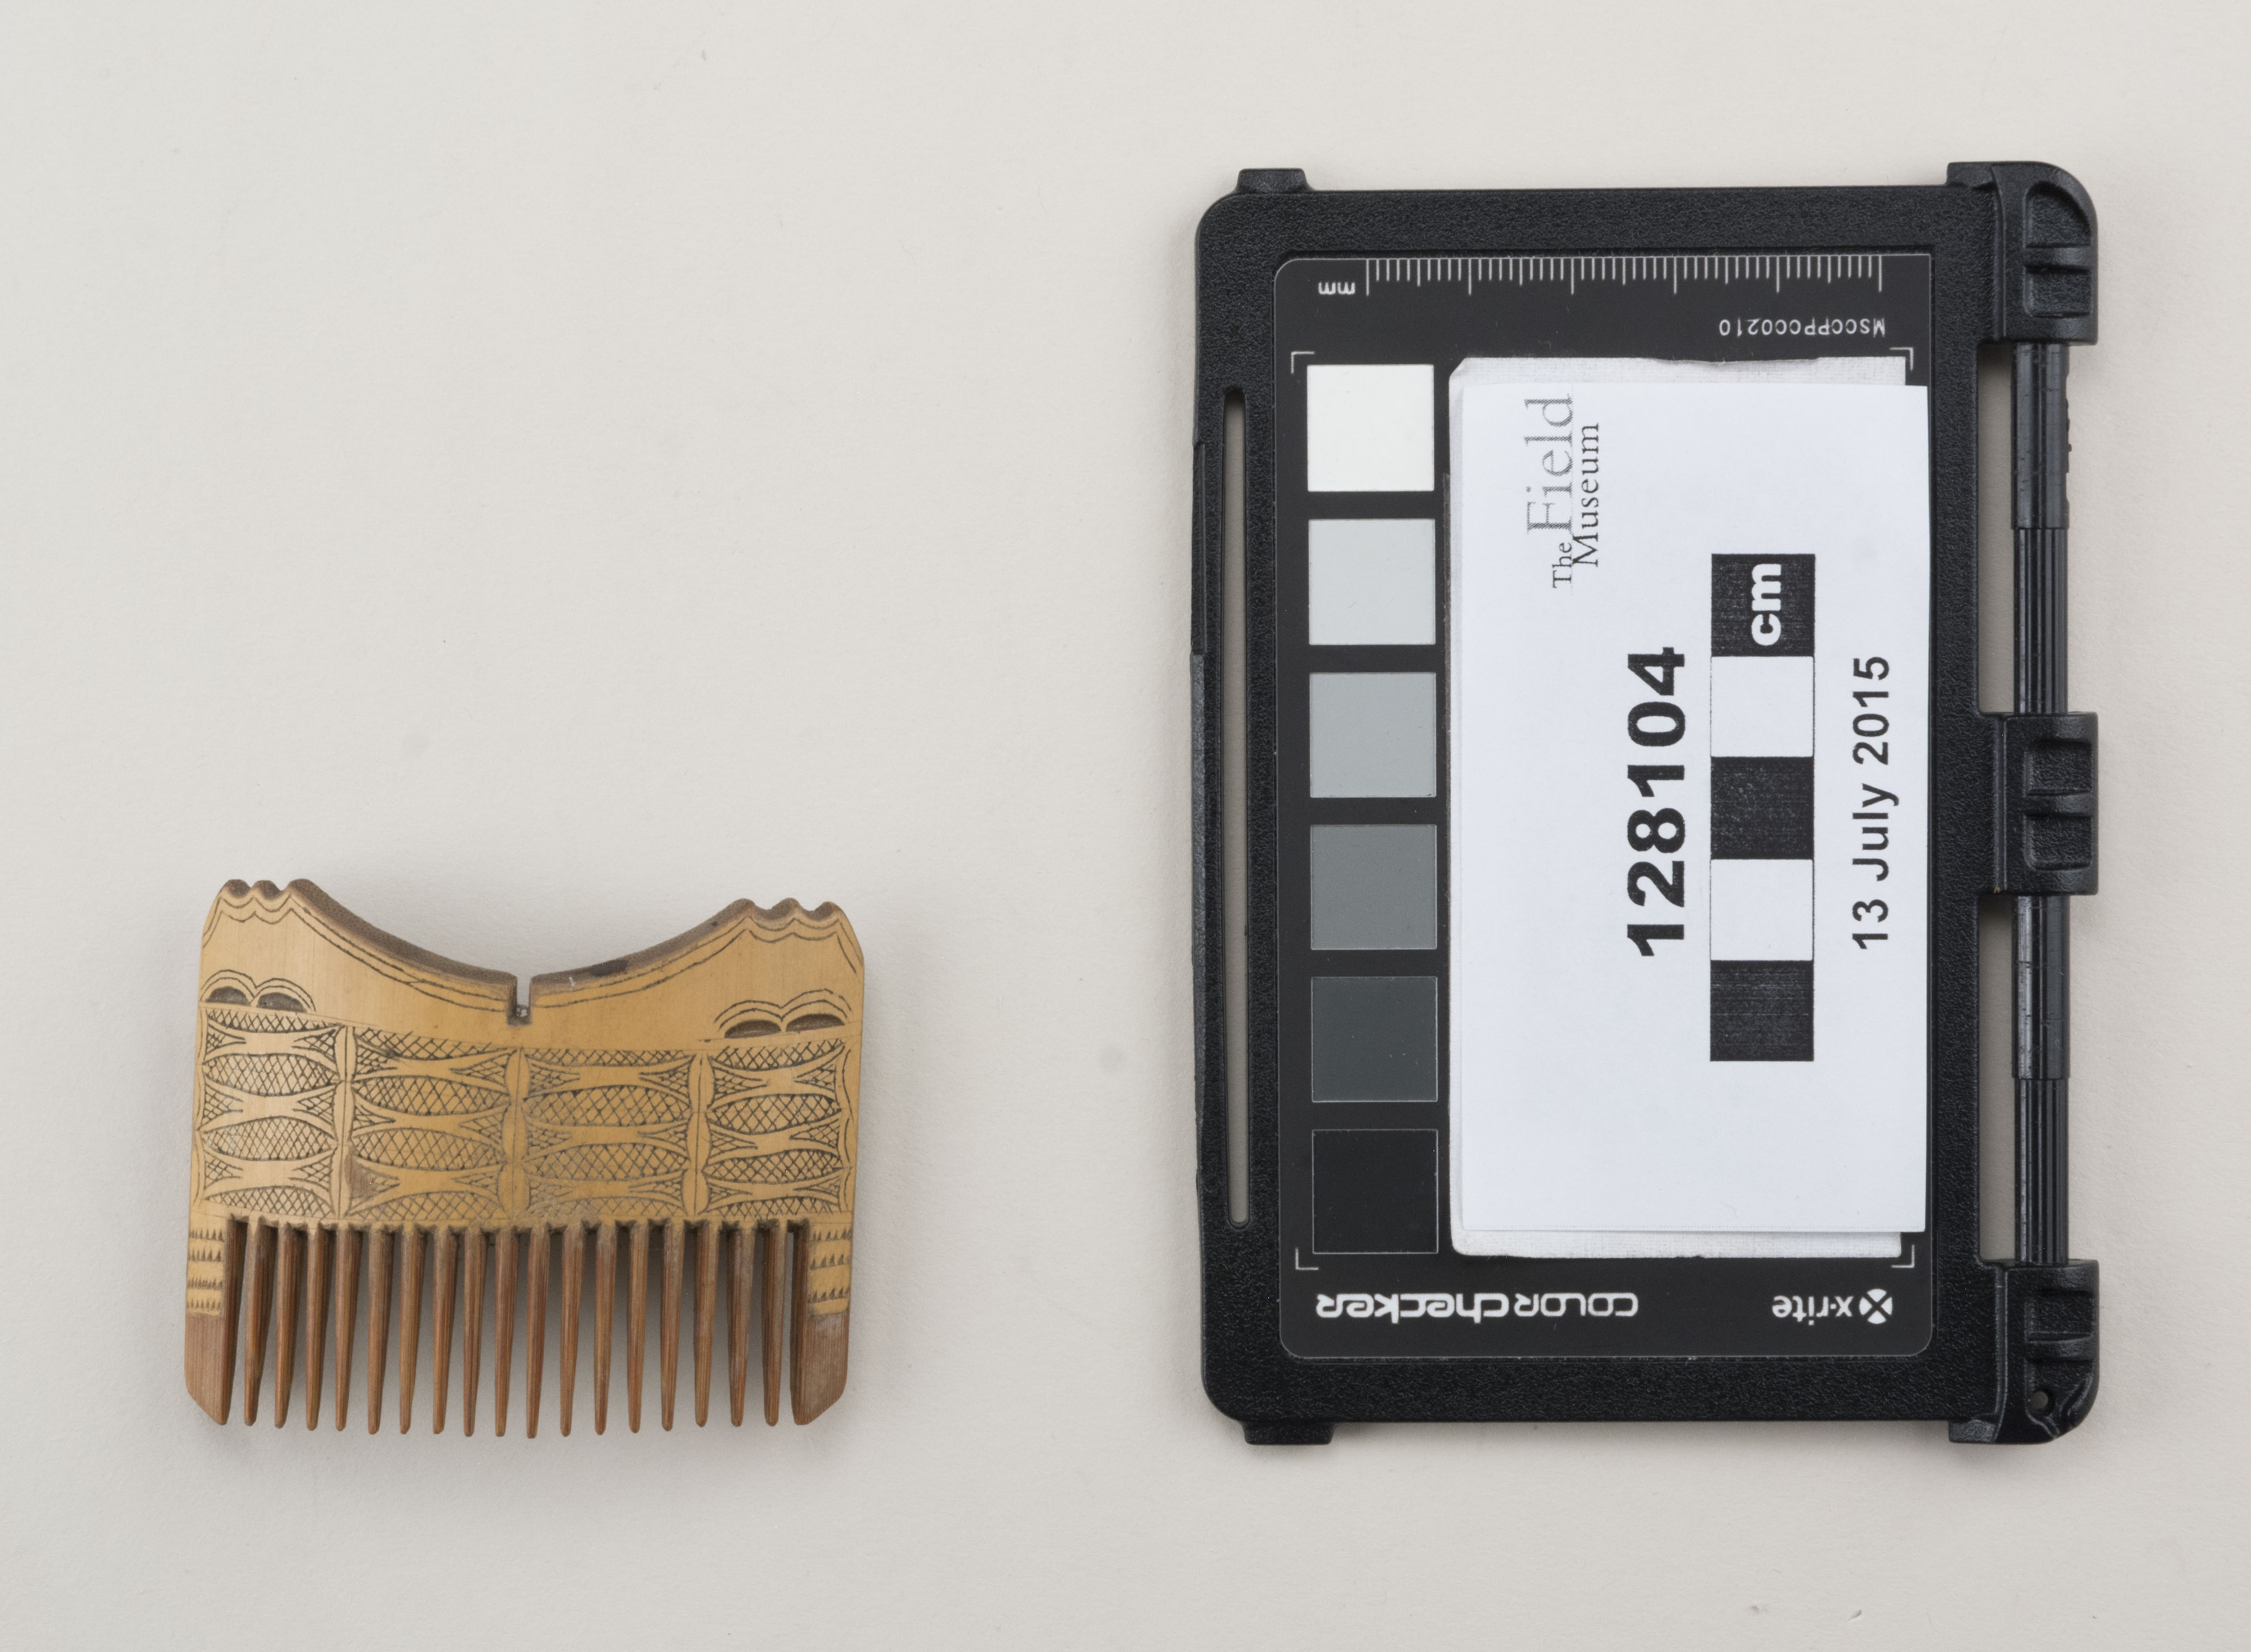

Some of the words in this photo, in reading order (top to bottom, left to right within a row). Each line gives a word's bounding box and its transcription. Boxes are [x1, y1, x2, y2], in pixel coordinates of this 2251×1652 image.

[1318, 282, 1356, 295] mm
[1524, 393, 1573, 534] Field
[1572, 423, 1599, 568] Museum
[1551, 542, 1572, 589] The
[1751, 563, 1782, 646] cm
[1852, 656, 1889, 765] 2015
[1627, 647, 1686, 957] 128104
[1852, 783, 1899, 881] July
[1852, 899, 1889, 950] 13
